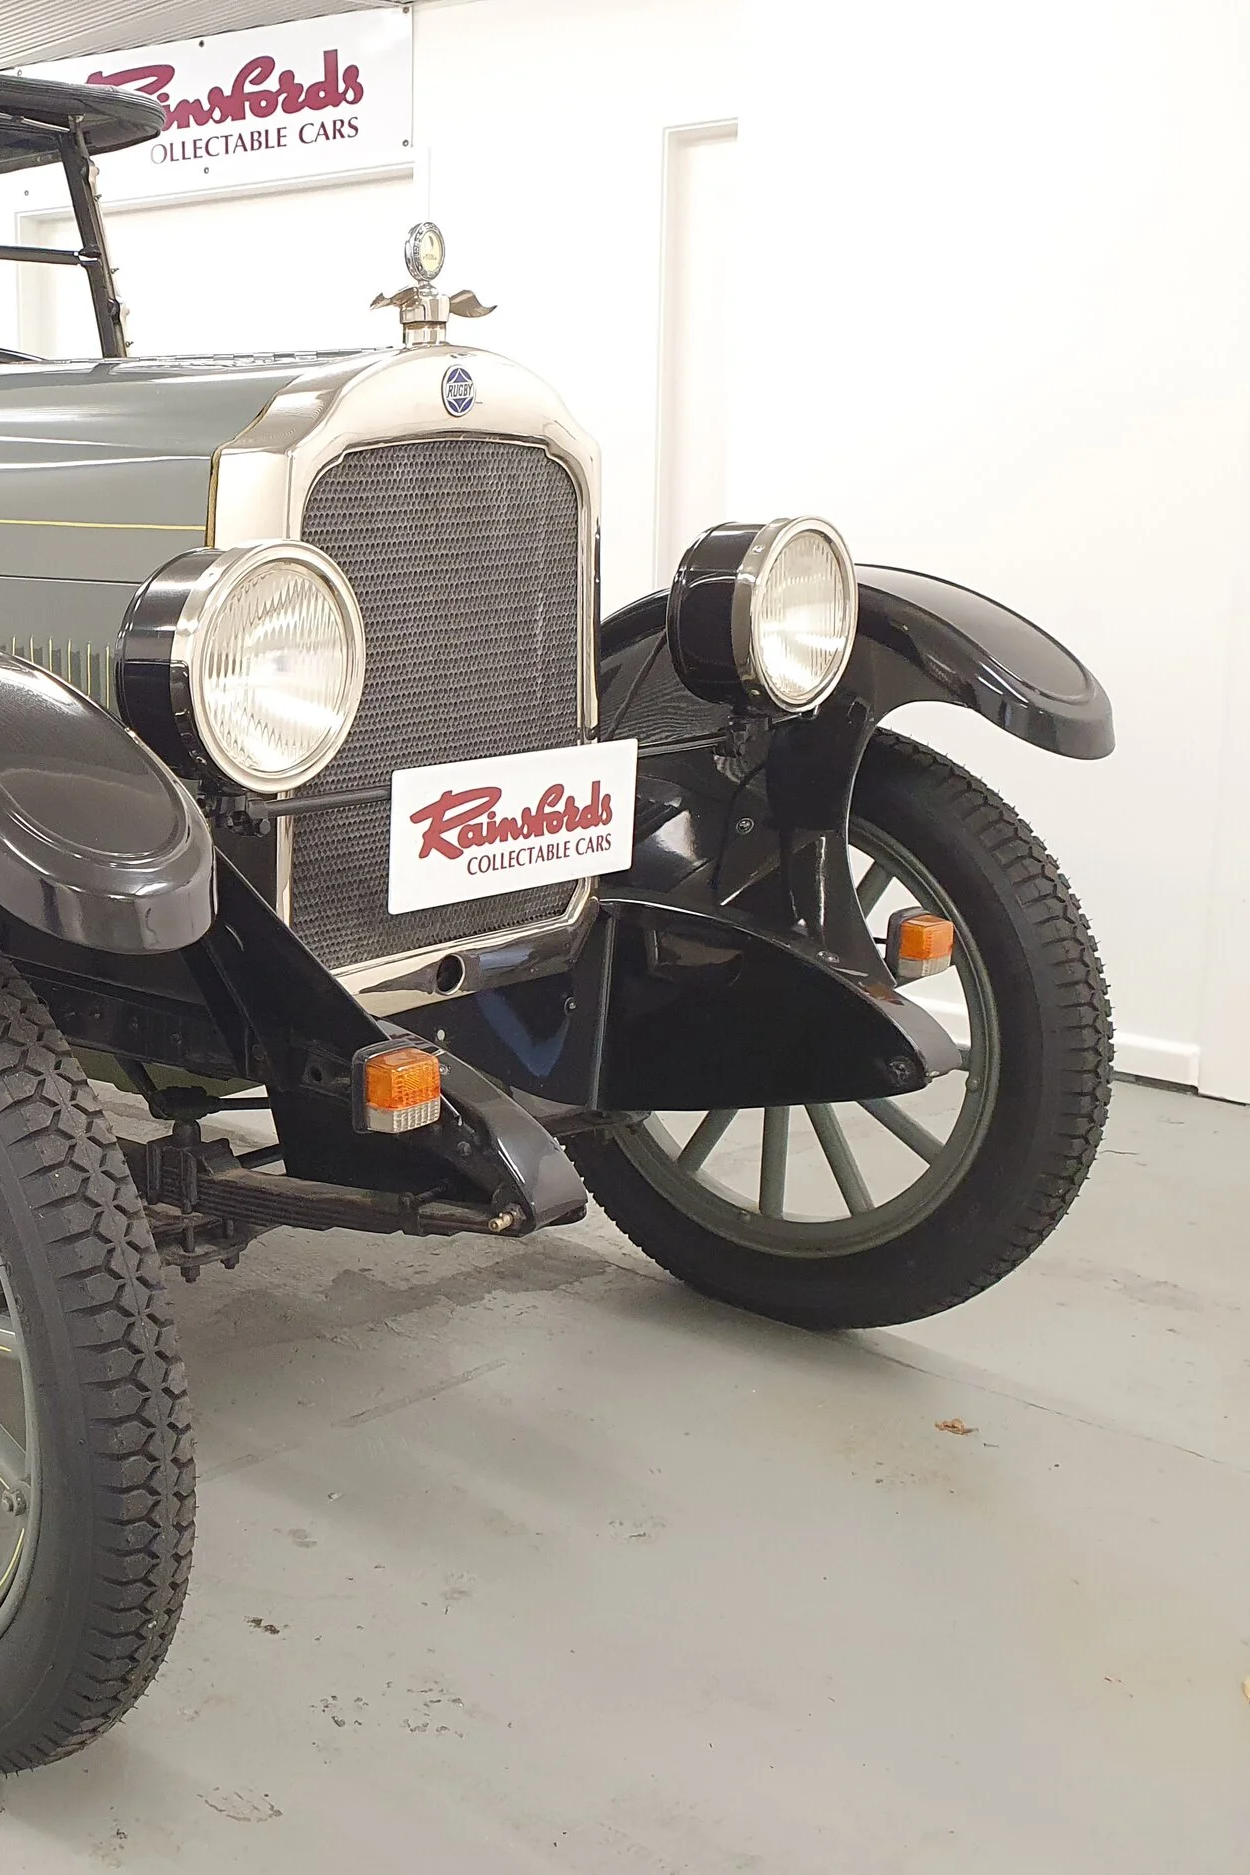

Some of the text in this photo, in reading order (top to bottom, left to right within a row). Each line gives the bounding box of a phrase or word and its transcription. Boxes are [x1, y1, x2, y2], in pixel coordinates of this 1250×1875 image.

[86, 50, 364, 132] insfords
[150, 116, 359, 165] OLLECTABLE CARS
[446, 383, 473, 399] RUGBY
[409, 780, 613, 860] Rainsfords
[466, 833, 612, 876] COLLECTABLE CARS
